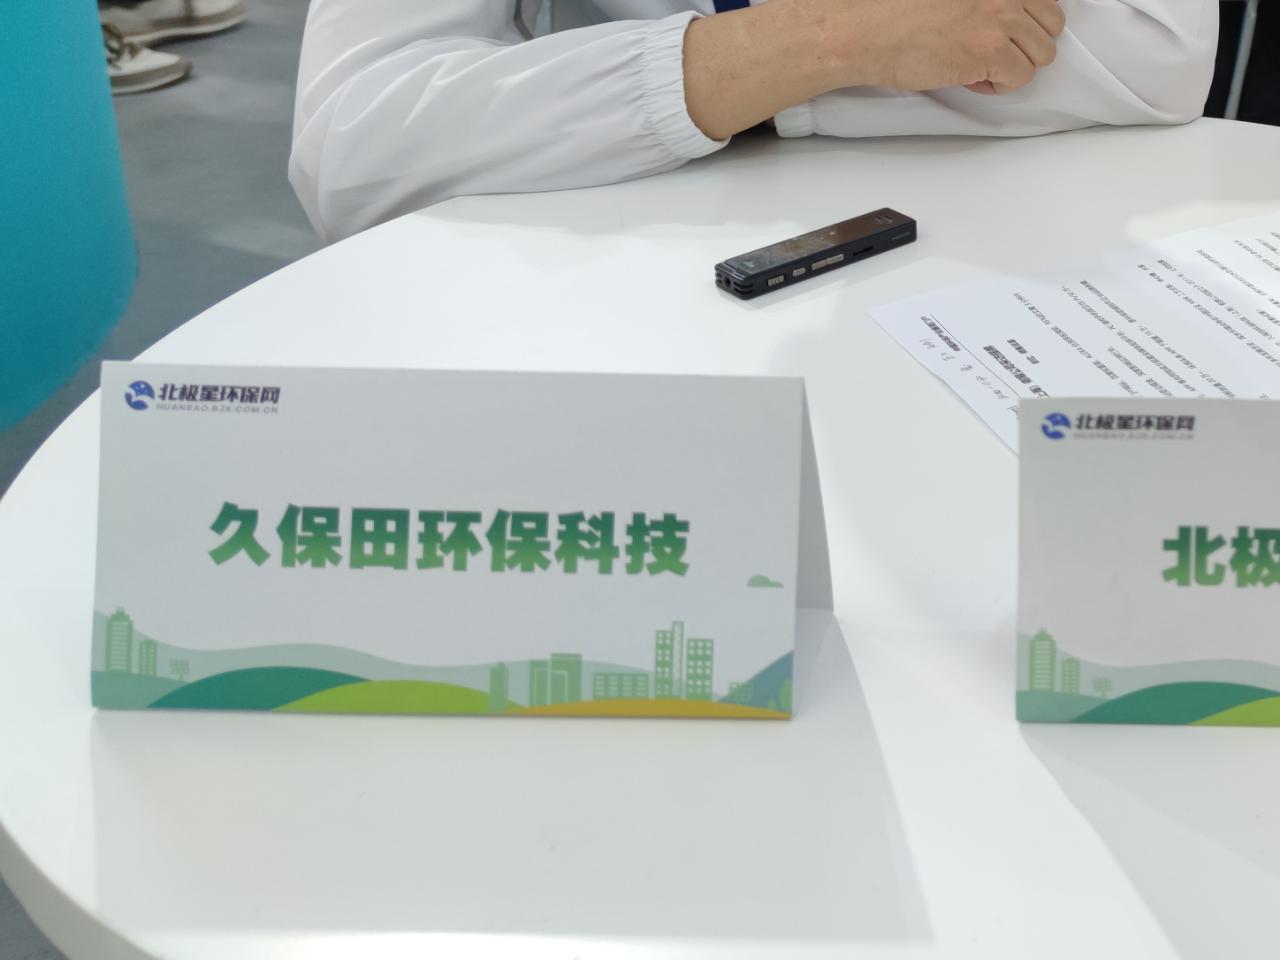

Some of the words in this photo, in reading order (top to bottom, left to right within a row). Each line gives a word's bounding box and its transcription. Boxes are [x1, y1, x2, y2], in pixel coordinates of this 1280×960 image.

[158, 383, 281, 405] 北极星环保网
[1075, 413, 1196, 431] 北极星环保网
[207, 501, 691, 578] 久保田环保科技
